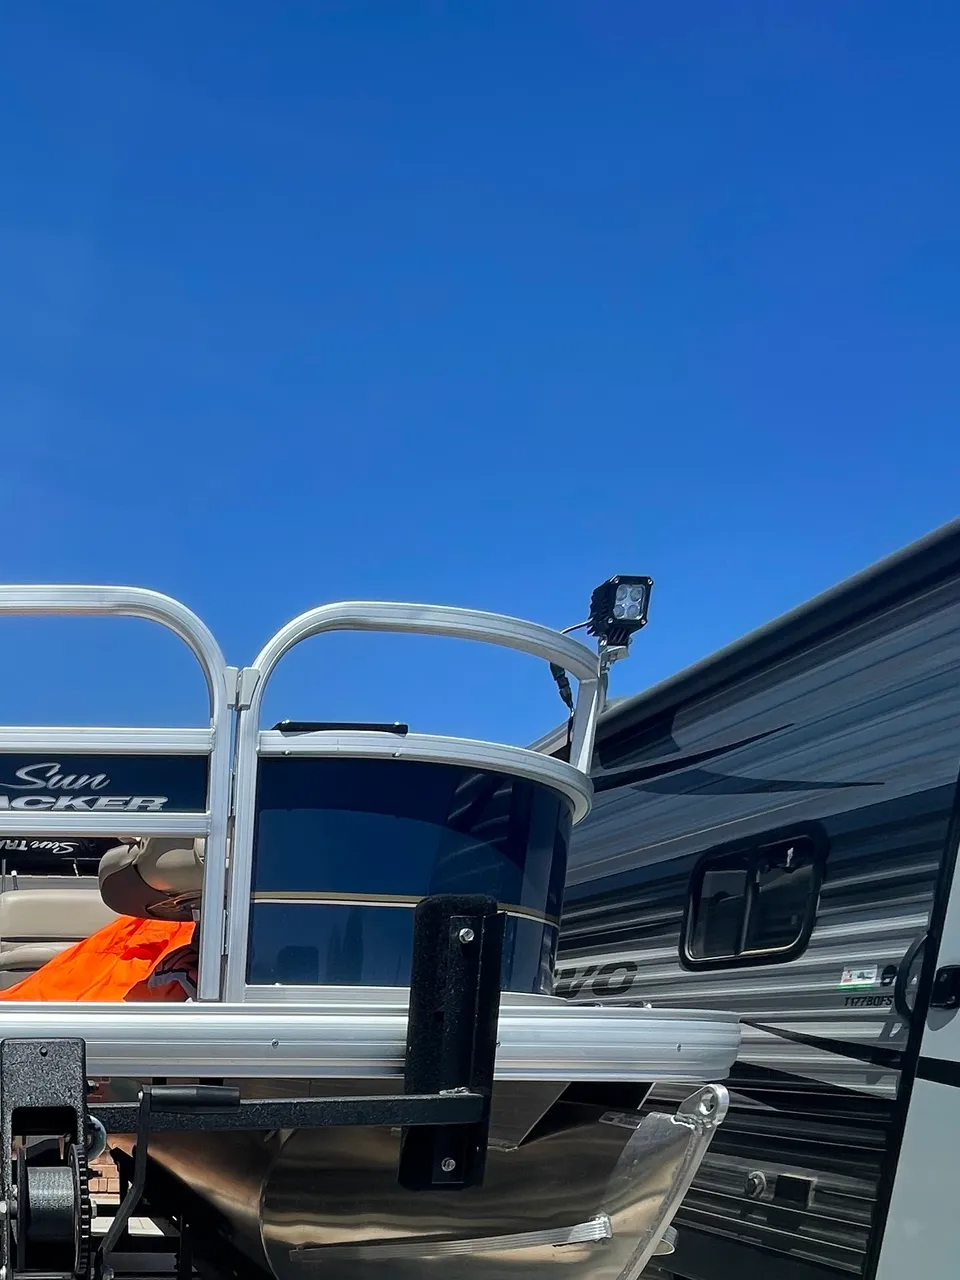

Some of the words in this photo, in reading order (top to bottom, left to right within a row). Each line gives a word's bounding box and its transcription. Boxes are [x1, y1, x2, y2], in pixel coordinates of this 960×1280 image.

[0, 762, 110, 790] Sun
[30, 840, 79, 854] Sun
[553, 961, 638, 998] VO
